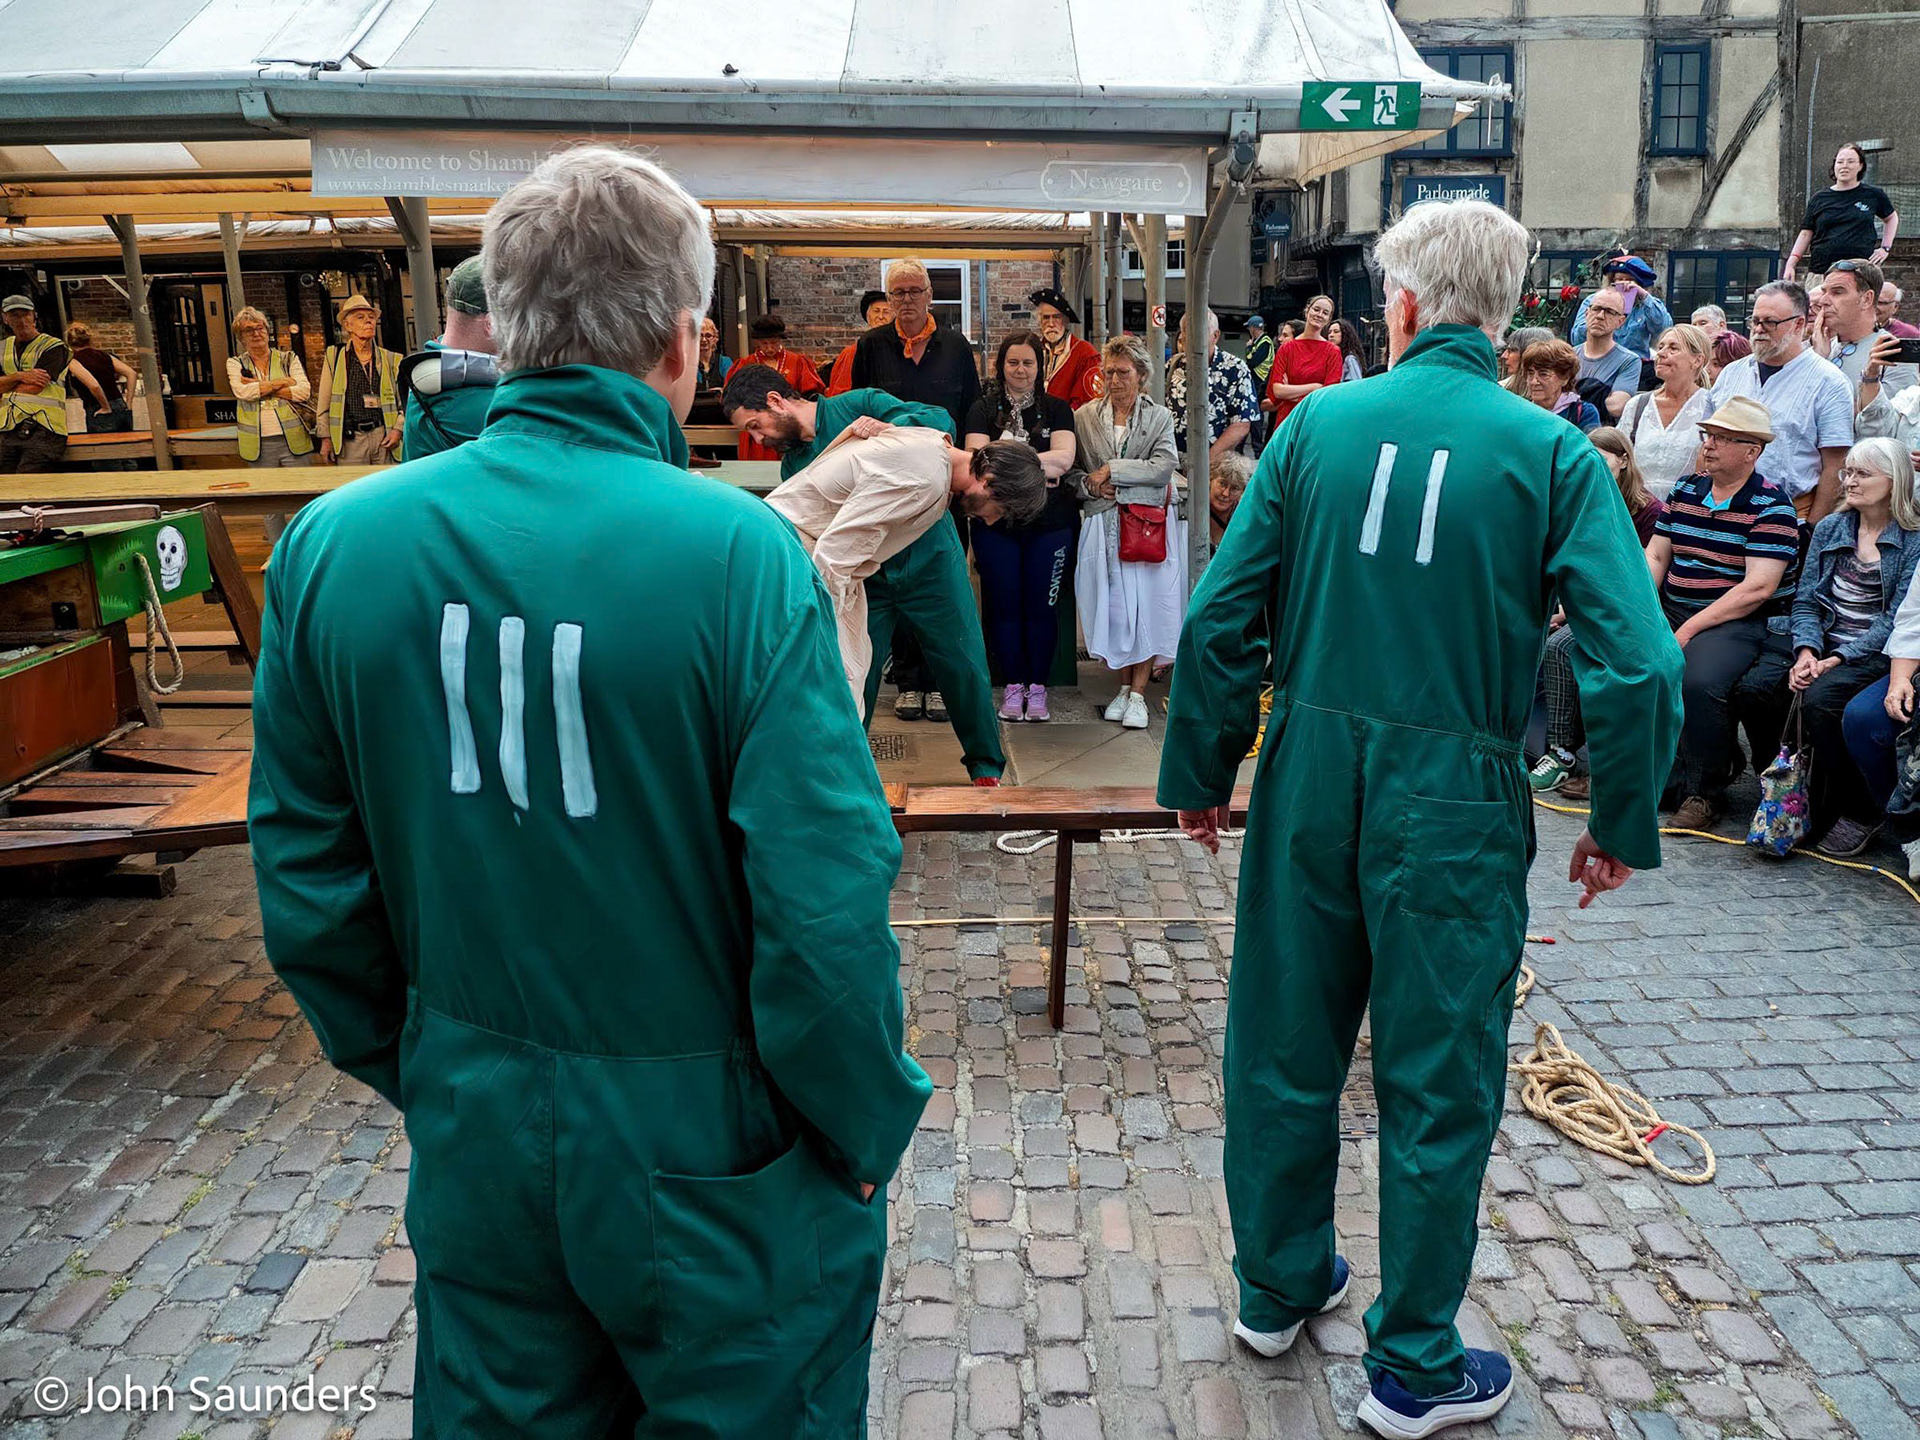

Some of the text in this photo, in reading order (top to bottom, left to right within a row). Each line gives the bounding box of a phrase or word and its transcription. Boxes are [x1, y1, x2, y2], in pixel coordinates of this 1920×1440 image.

[326, 147, 434, 171] Welcome
[441, 153, 462, 171] to
[1069, 169, 1162, 197] Newgate
[1417, 183, 1490, 200] Parlormade
[1048, 545, 1067, 606] CONTRA
